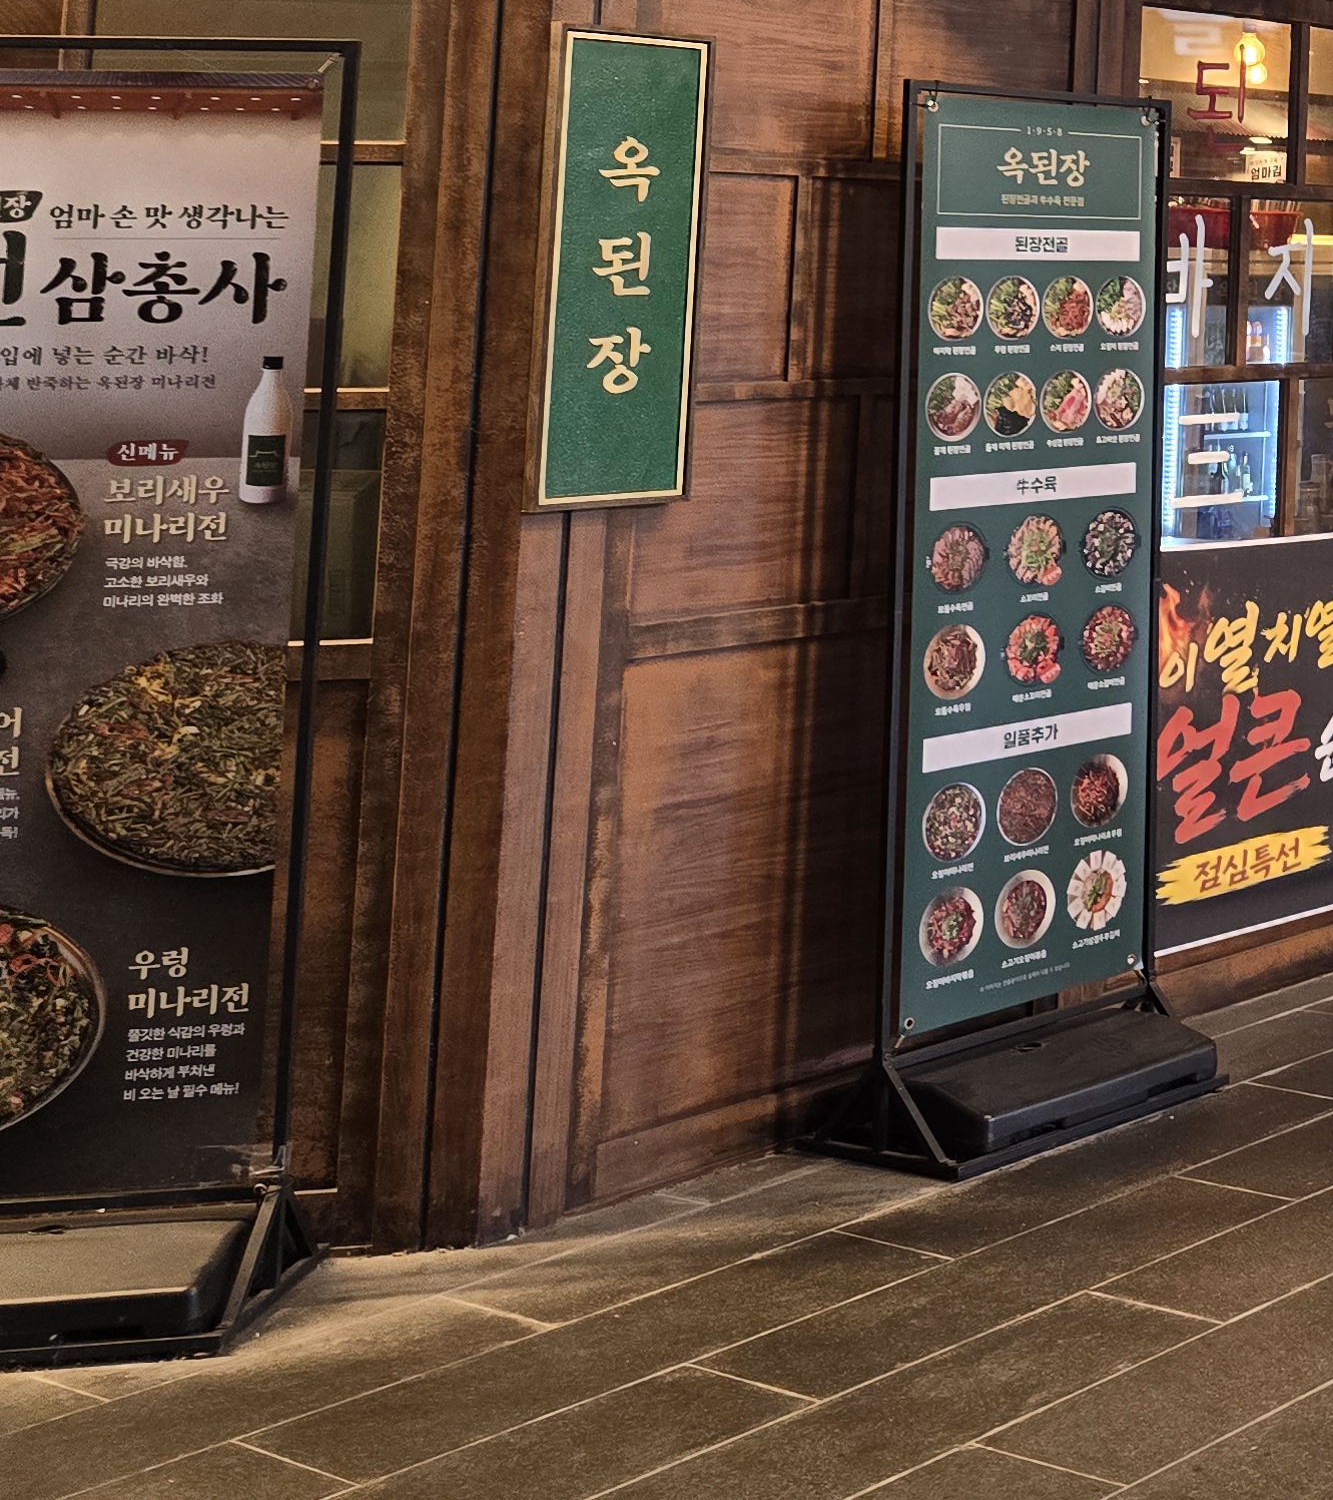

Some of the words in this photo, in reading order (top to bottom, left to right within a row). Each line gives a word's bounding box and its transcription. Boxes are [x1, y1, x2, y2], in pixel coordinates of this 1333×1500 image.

[996, 146, 1091, 187] 옥된장
[49, 203, 105, 230] 엄마
[109, 204, 138, 230] 손
[145, 203, 173, 230] 맛
[178, 203, 290, 230] 생각나는
[1014, 235, 1069, 253] 된장전골
[586, 135, 661, 395] 옥된장
[40, 250, 288, 326] 삼총사
[53, 345, 95, 367] 넣는
[102, 345, 149, 366] 순간
[155, 344, 209, 364] 바삭!
[27, 375, 91, 391] 반죽하는
[151, 374, 216, 390] 미나리전
[116, 442, 180, 462] 신메뉴
[103, 474, 230, 506] 보리새우
[103, 511, 228, 544] 미나리전
[104, 557, 144, 570] 극강의
[103, 575, 142, 588] 고소한
[145, 573, 210, 588] 보리새우와
[103, 594, 154, 608] 미나리의
[197, 591, 224, 605] 조화
[1002, 722, 1060, 750] 일품추가
[1156, 686, 1313, 845] 얼큰
[1193, 835, 1303, 893] 점심특선
[128, 946, 190, 981] 우렁
[127, 982, 250, 1019] 미나리전
[167, 1024, 206, 1040] 식감의
[207, 1022, 246, 1038] 우렁과
[125, 1046, 165, 1062] 건강한
[166, 1043, 217, 1060] 미나리를
[124, 1065, 176, 1082] 바삭하게
[122, 1088, 137, 1102] 비
[138, 1087, 165, 1100] 오는
[167, 1084, 181, 1099] 날
[182, 1083, 208, 1098] 필수
